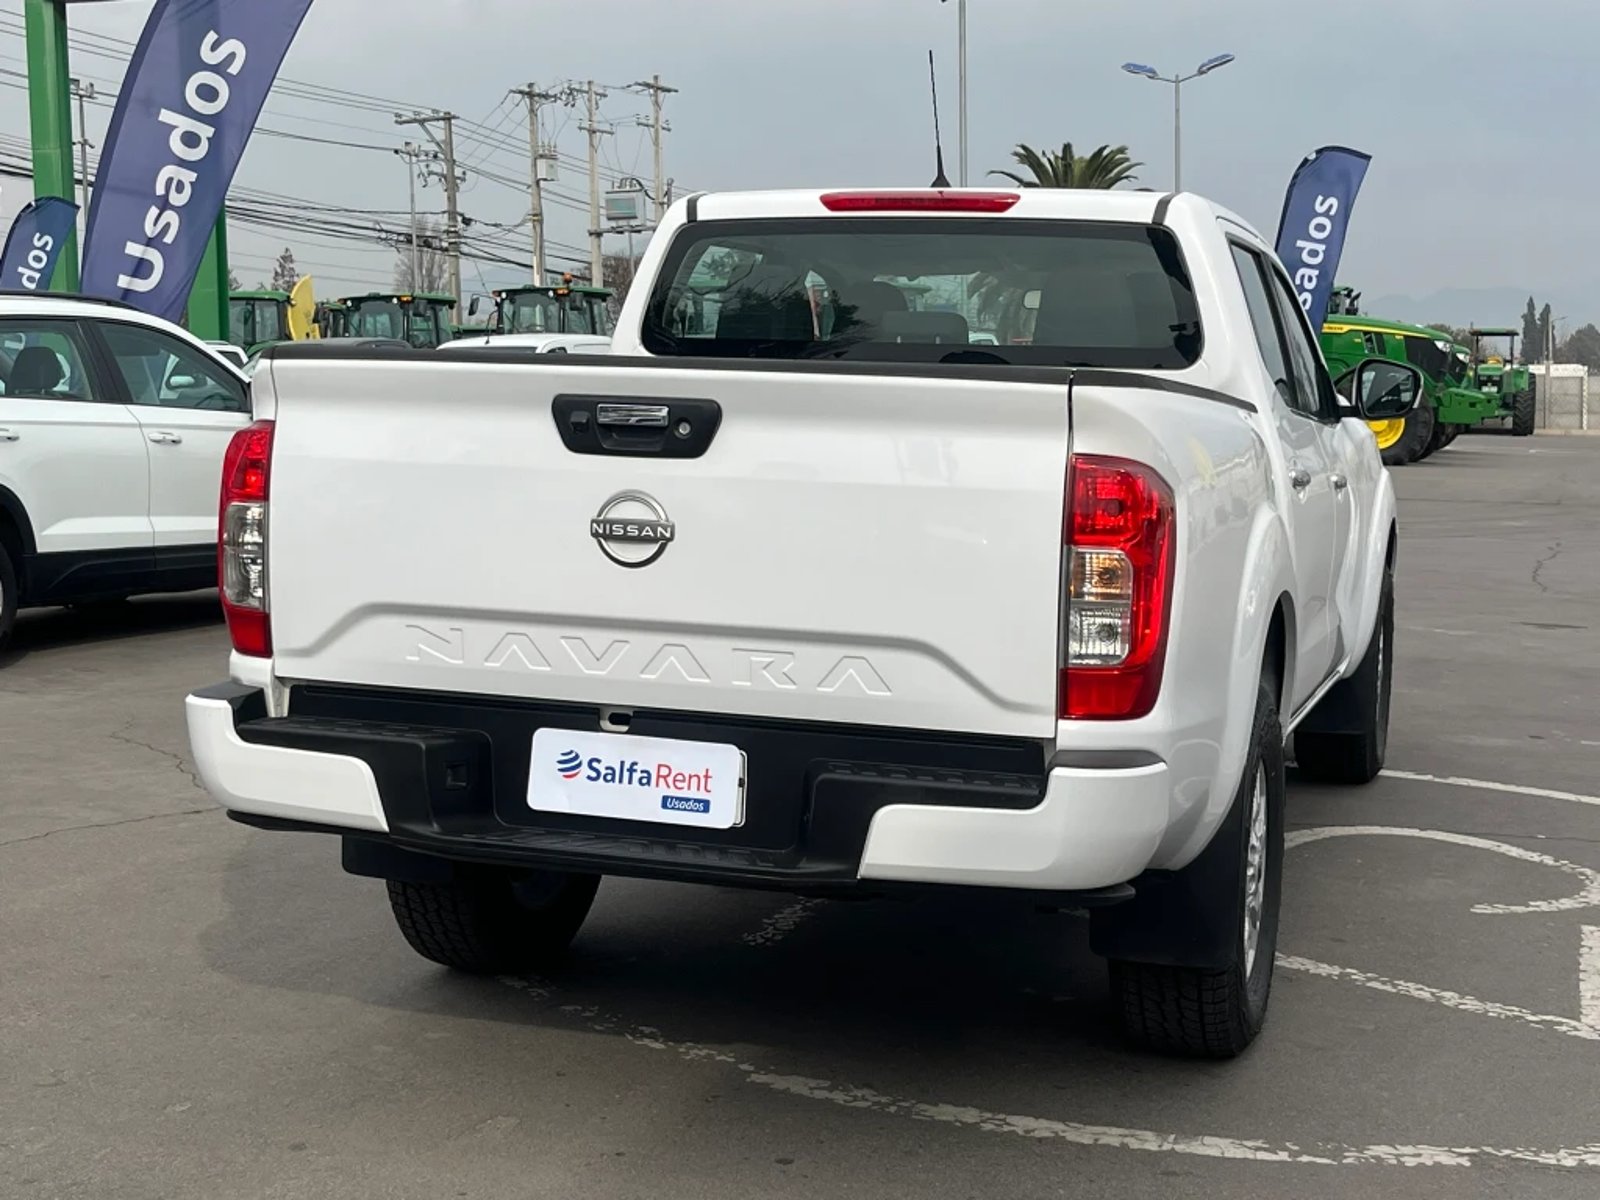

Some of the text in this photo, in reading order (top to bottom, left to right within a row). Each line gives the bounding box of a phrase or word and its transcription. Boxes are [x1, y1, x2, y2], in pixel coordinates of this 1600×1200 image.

[117, 30, 246, 293] Usados
[591, 522, 672, 539] NISSAN
[405, 624, 892, 695] NAVARA
[586, 757, 712, 793] SalfaRent
[667, 798, 704, 812] Usados
